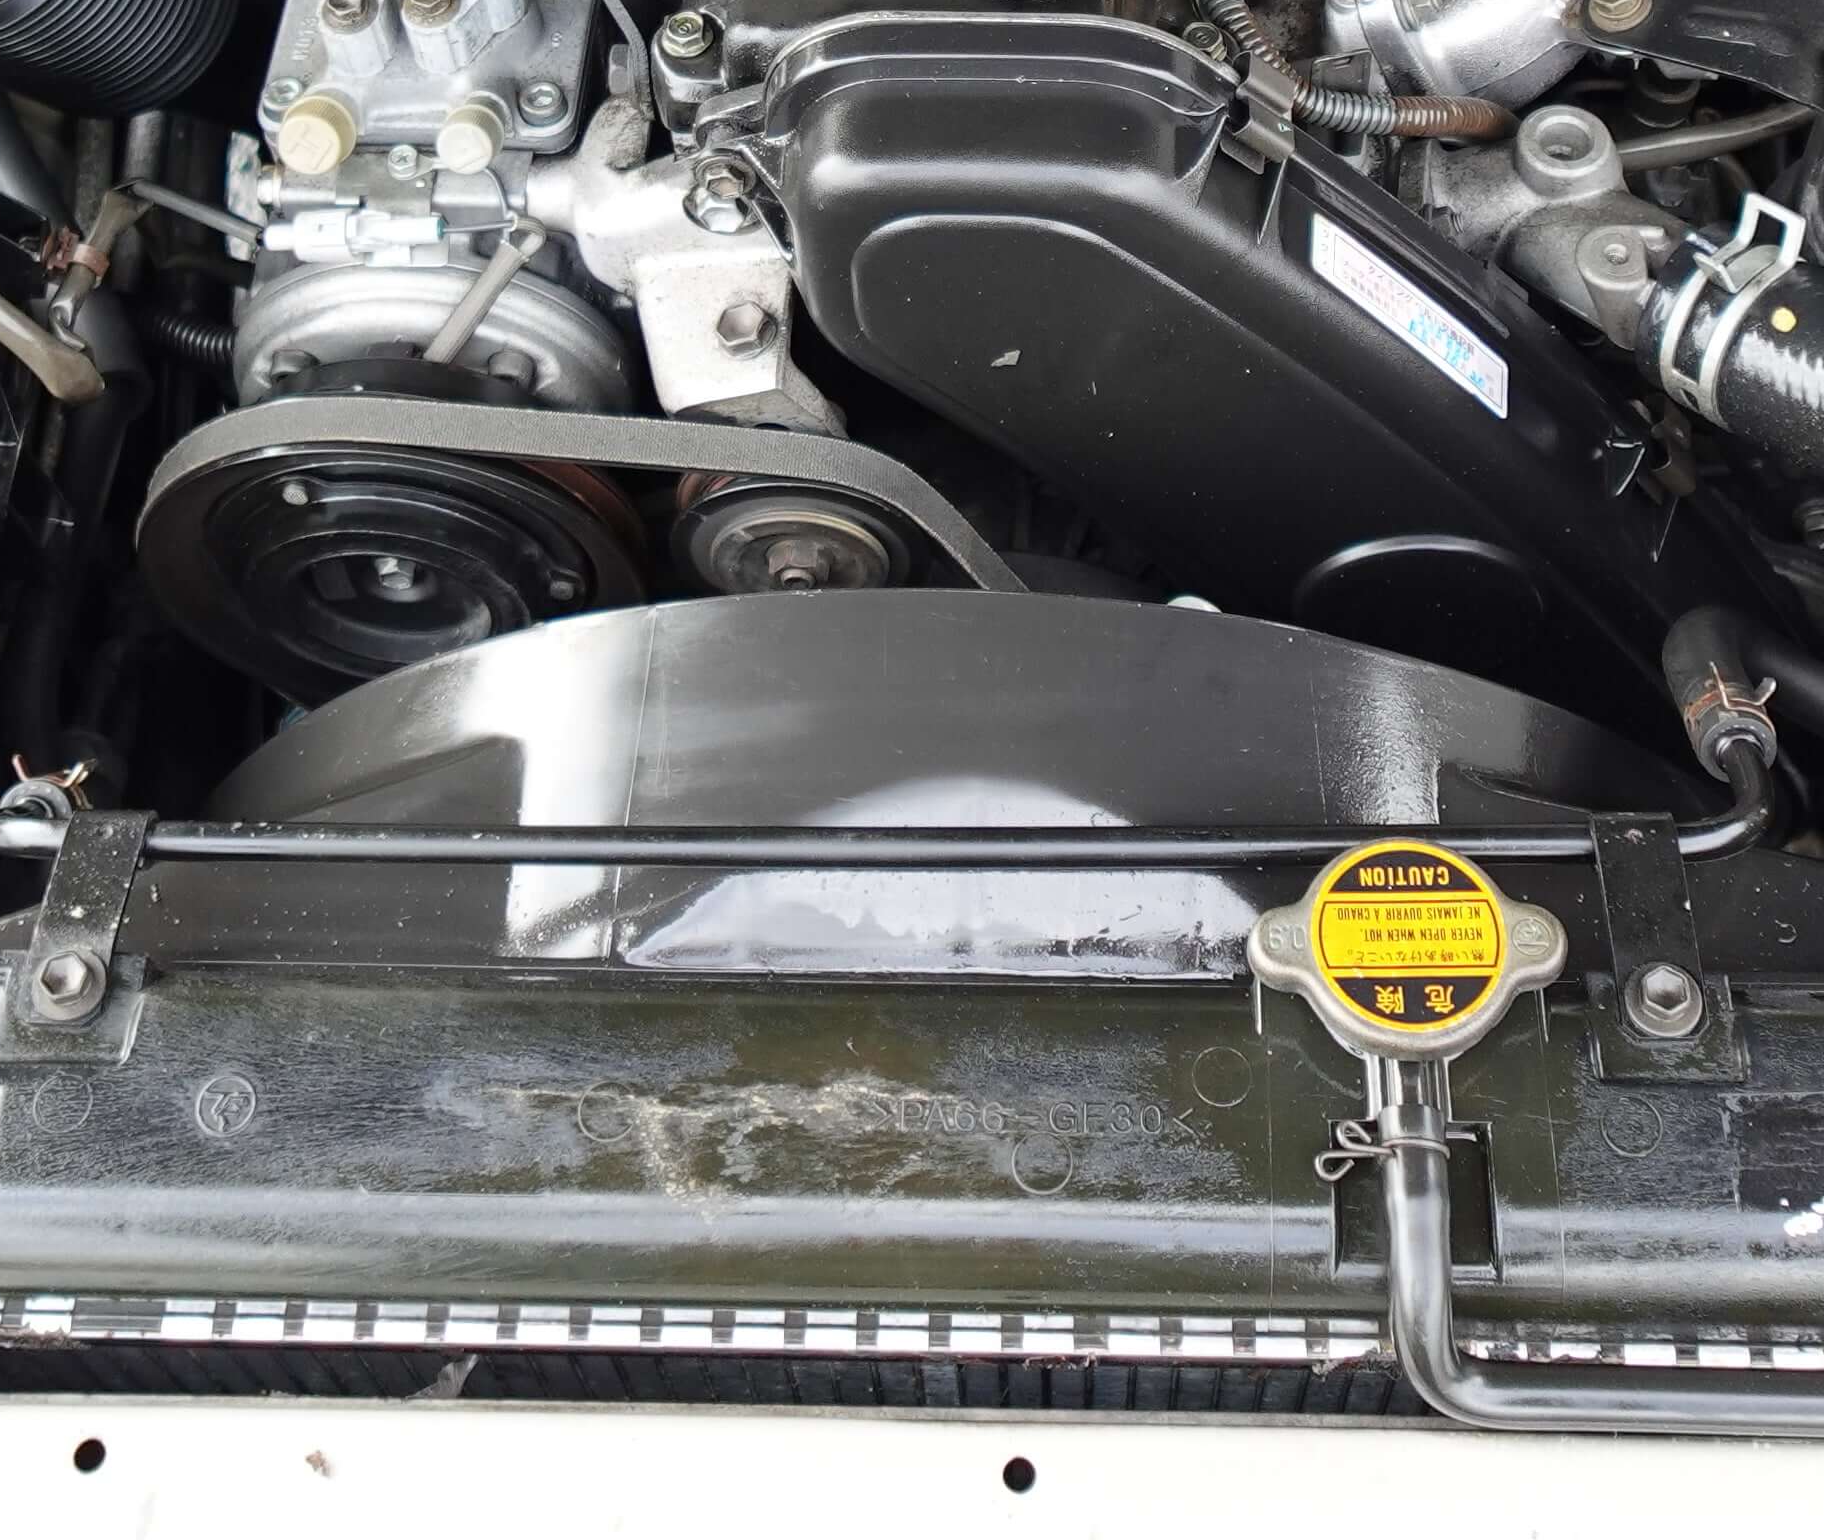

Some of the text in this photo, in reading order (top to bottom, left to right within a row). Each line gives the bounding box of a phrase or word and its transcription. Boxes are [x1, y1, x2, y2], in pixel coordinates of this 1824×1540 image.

[1359, 866, 1449, 887] CAUTION
[1385, 907, 1422, 919] OUVRIR
[1425, 907, 1463, 919] JAMAIS
[1467, 907, 1481, 918] NE
[1360, 928, 1483, 941] NEVER OPEN WHEN HOT.
